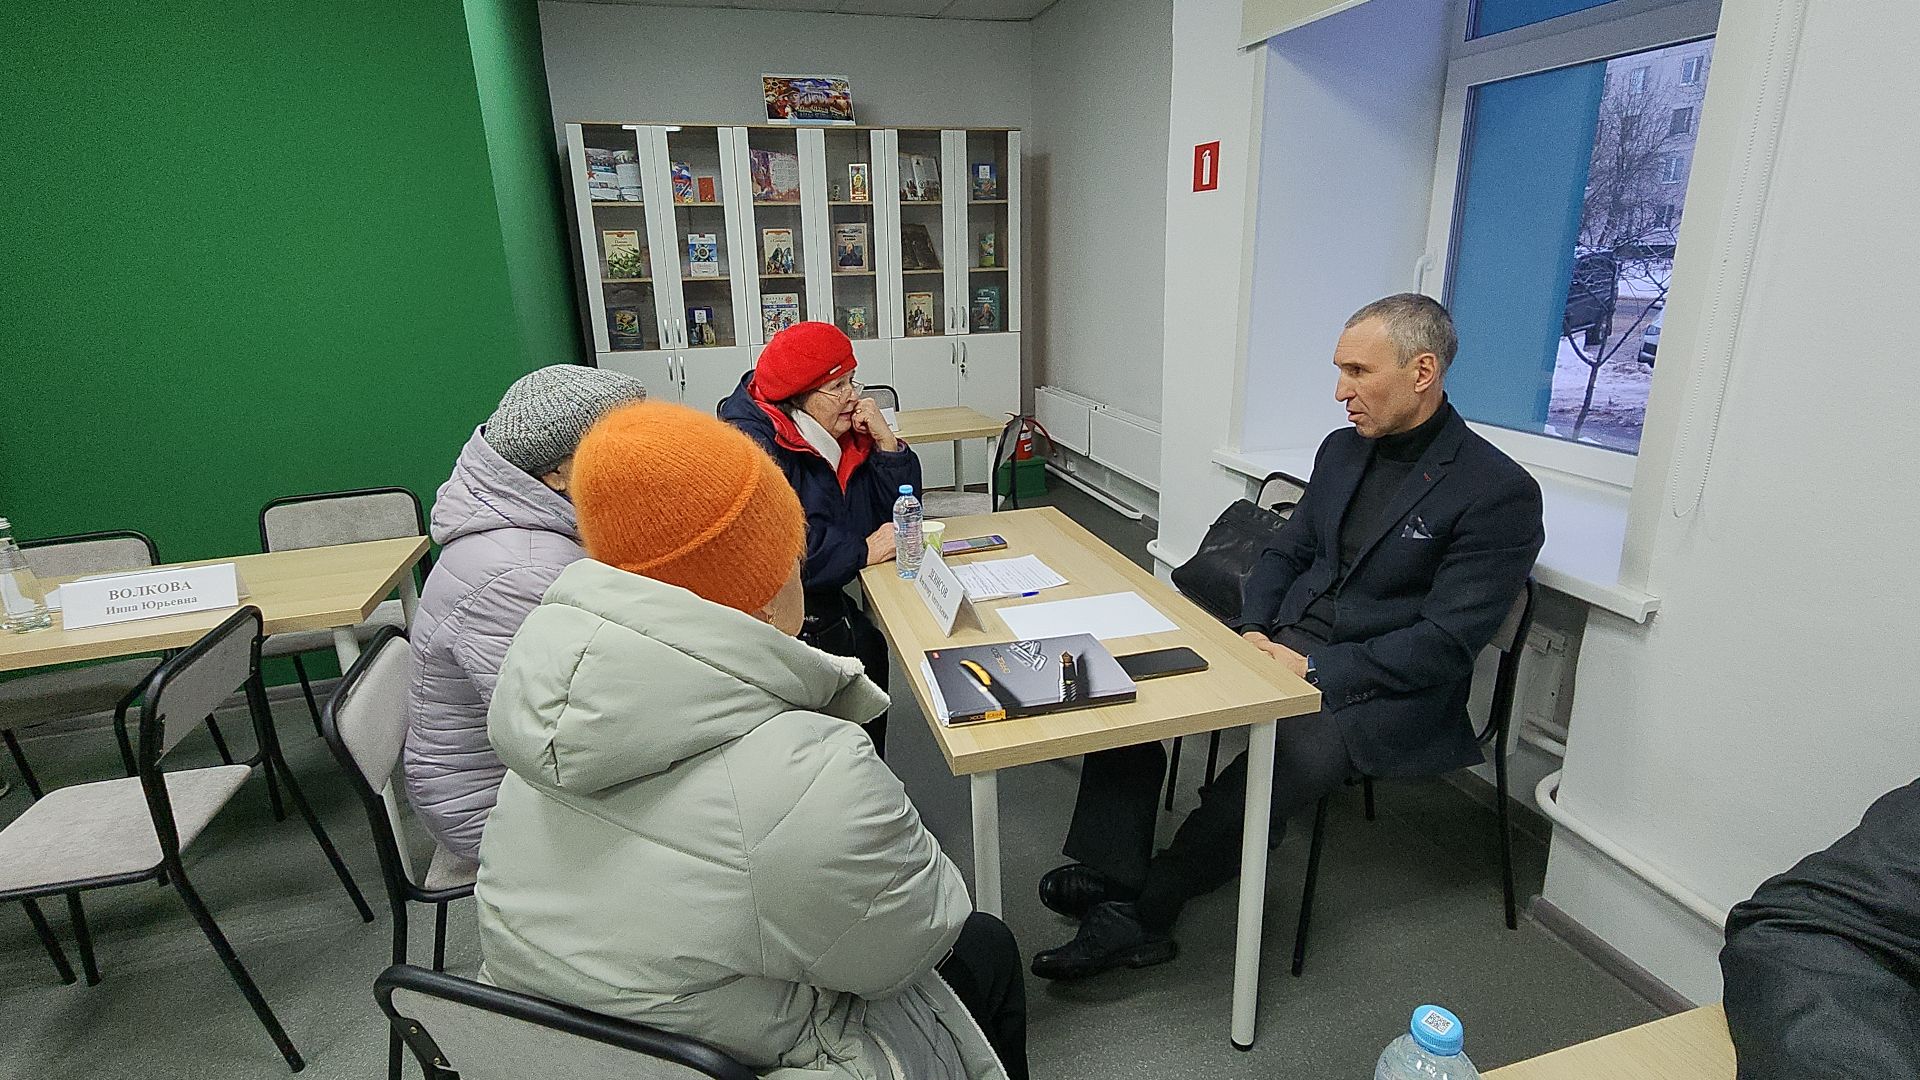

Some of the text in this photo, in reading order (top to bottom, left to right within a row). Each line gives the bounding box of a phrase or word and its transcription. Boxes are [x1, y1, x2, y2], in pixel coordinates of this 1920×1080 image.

[109, 580, 192, 600] ВОЛКОВА
[106, 596, 198, 615] Инна Юрьевна
